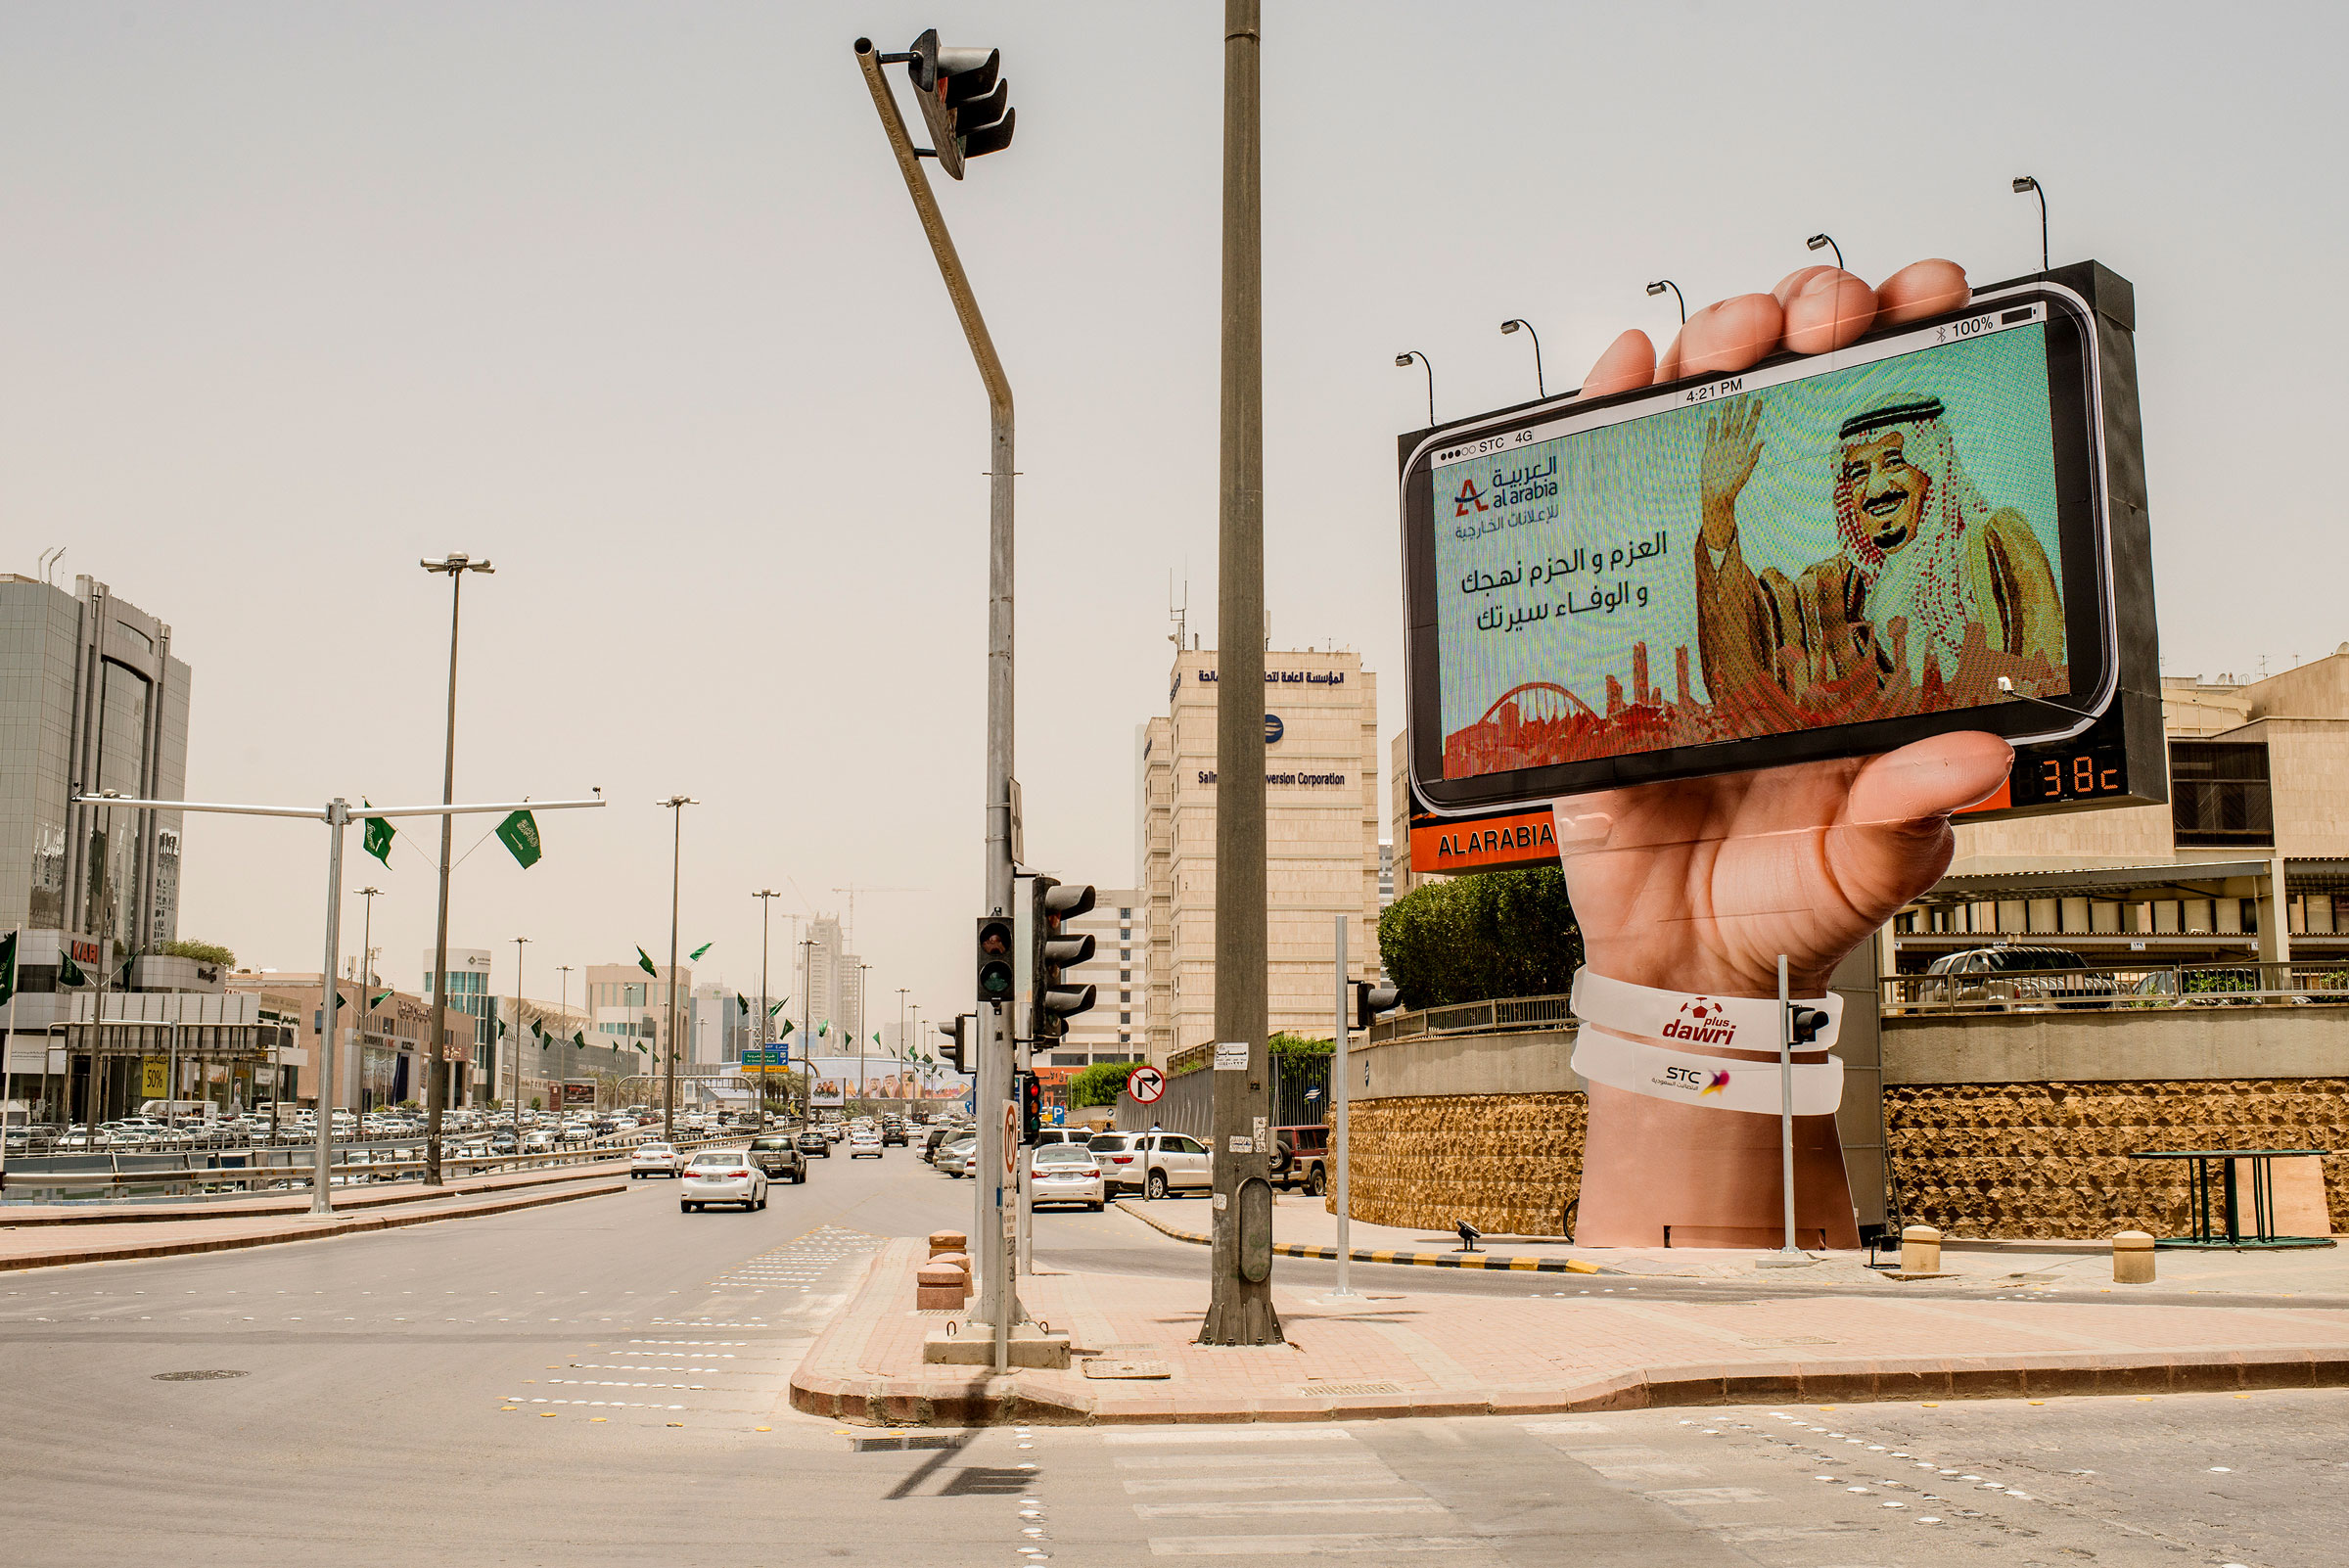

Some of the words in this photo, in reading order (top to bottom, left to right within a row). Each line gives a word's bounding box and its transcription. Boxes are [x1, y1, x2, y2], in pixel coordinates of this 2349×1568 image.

[1951, 315, 1994, 338] 100%
[1685, 386, 1716, 403] 4:21
[1719, 378, 1743, 399] PM
[1479, 437, 1505, 453] STC
[1514, 430, 1534, 443] 4G
[1492, 455, 1558, 488] العربية
[1493, 491, 1508, 508] al
[1509, 480, 1558, 505] arabia
[1454, 516, 1504, 540] الخارجية
[1610, 530, 1668, 571] العزم
[1529, 547, 1586, 587] الحزم
[1590, 552, 1603, 575] و
[1461, 560, 1522, 597] نهجك
[1554, 580, 1630, 618] الوفاء
[1636, 585, 1648, 607] و
[1476, 602, 1548, 632] سيرتك
[1265, 772, 1296, 785] version
[1298, 771, 1346, 788] Corporation
[1438, 823, 1555, 857] ALARABIA
[1662, 1019, 1736, 1045] dawri
[1703, 1016, 1730, 1028] plus
[147, 1069, 162, 1088] 50%
[1666, 1066, 1702, 1084] STC
[1053, 1107, 1063, 1119] P
